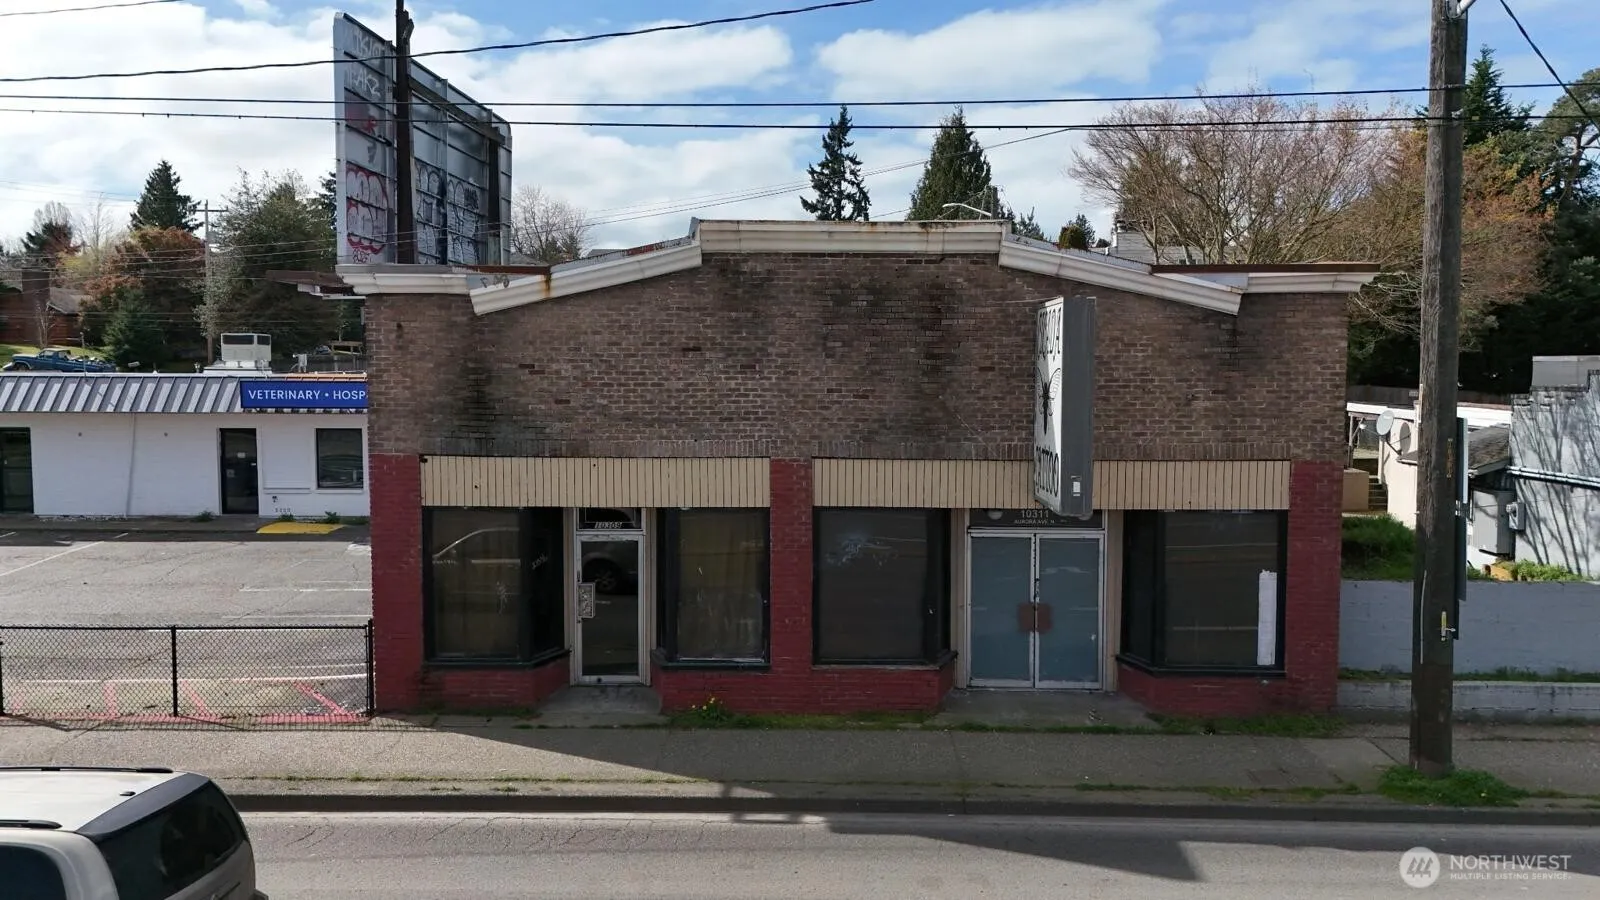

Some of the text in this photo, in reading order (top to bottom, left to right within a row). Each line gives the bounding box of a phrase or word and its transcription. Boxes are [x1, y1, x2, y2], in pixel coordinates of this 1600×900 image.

[248, 390, 368, 400] VETERINARY HOSP
[1021, 509, 1049, 518] 10311
